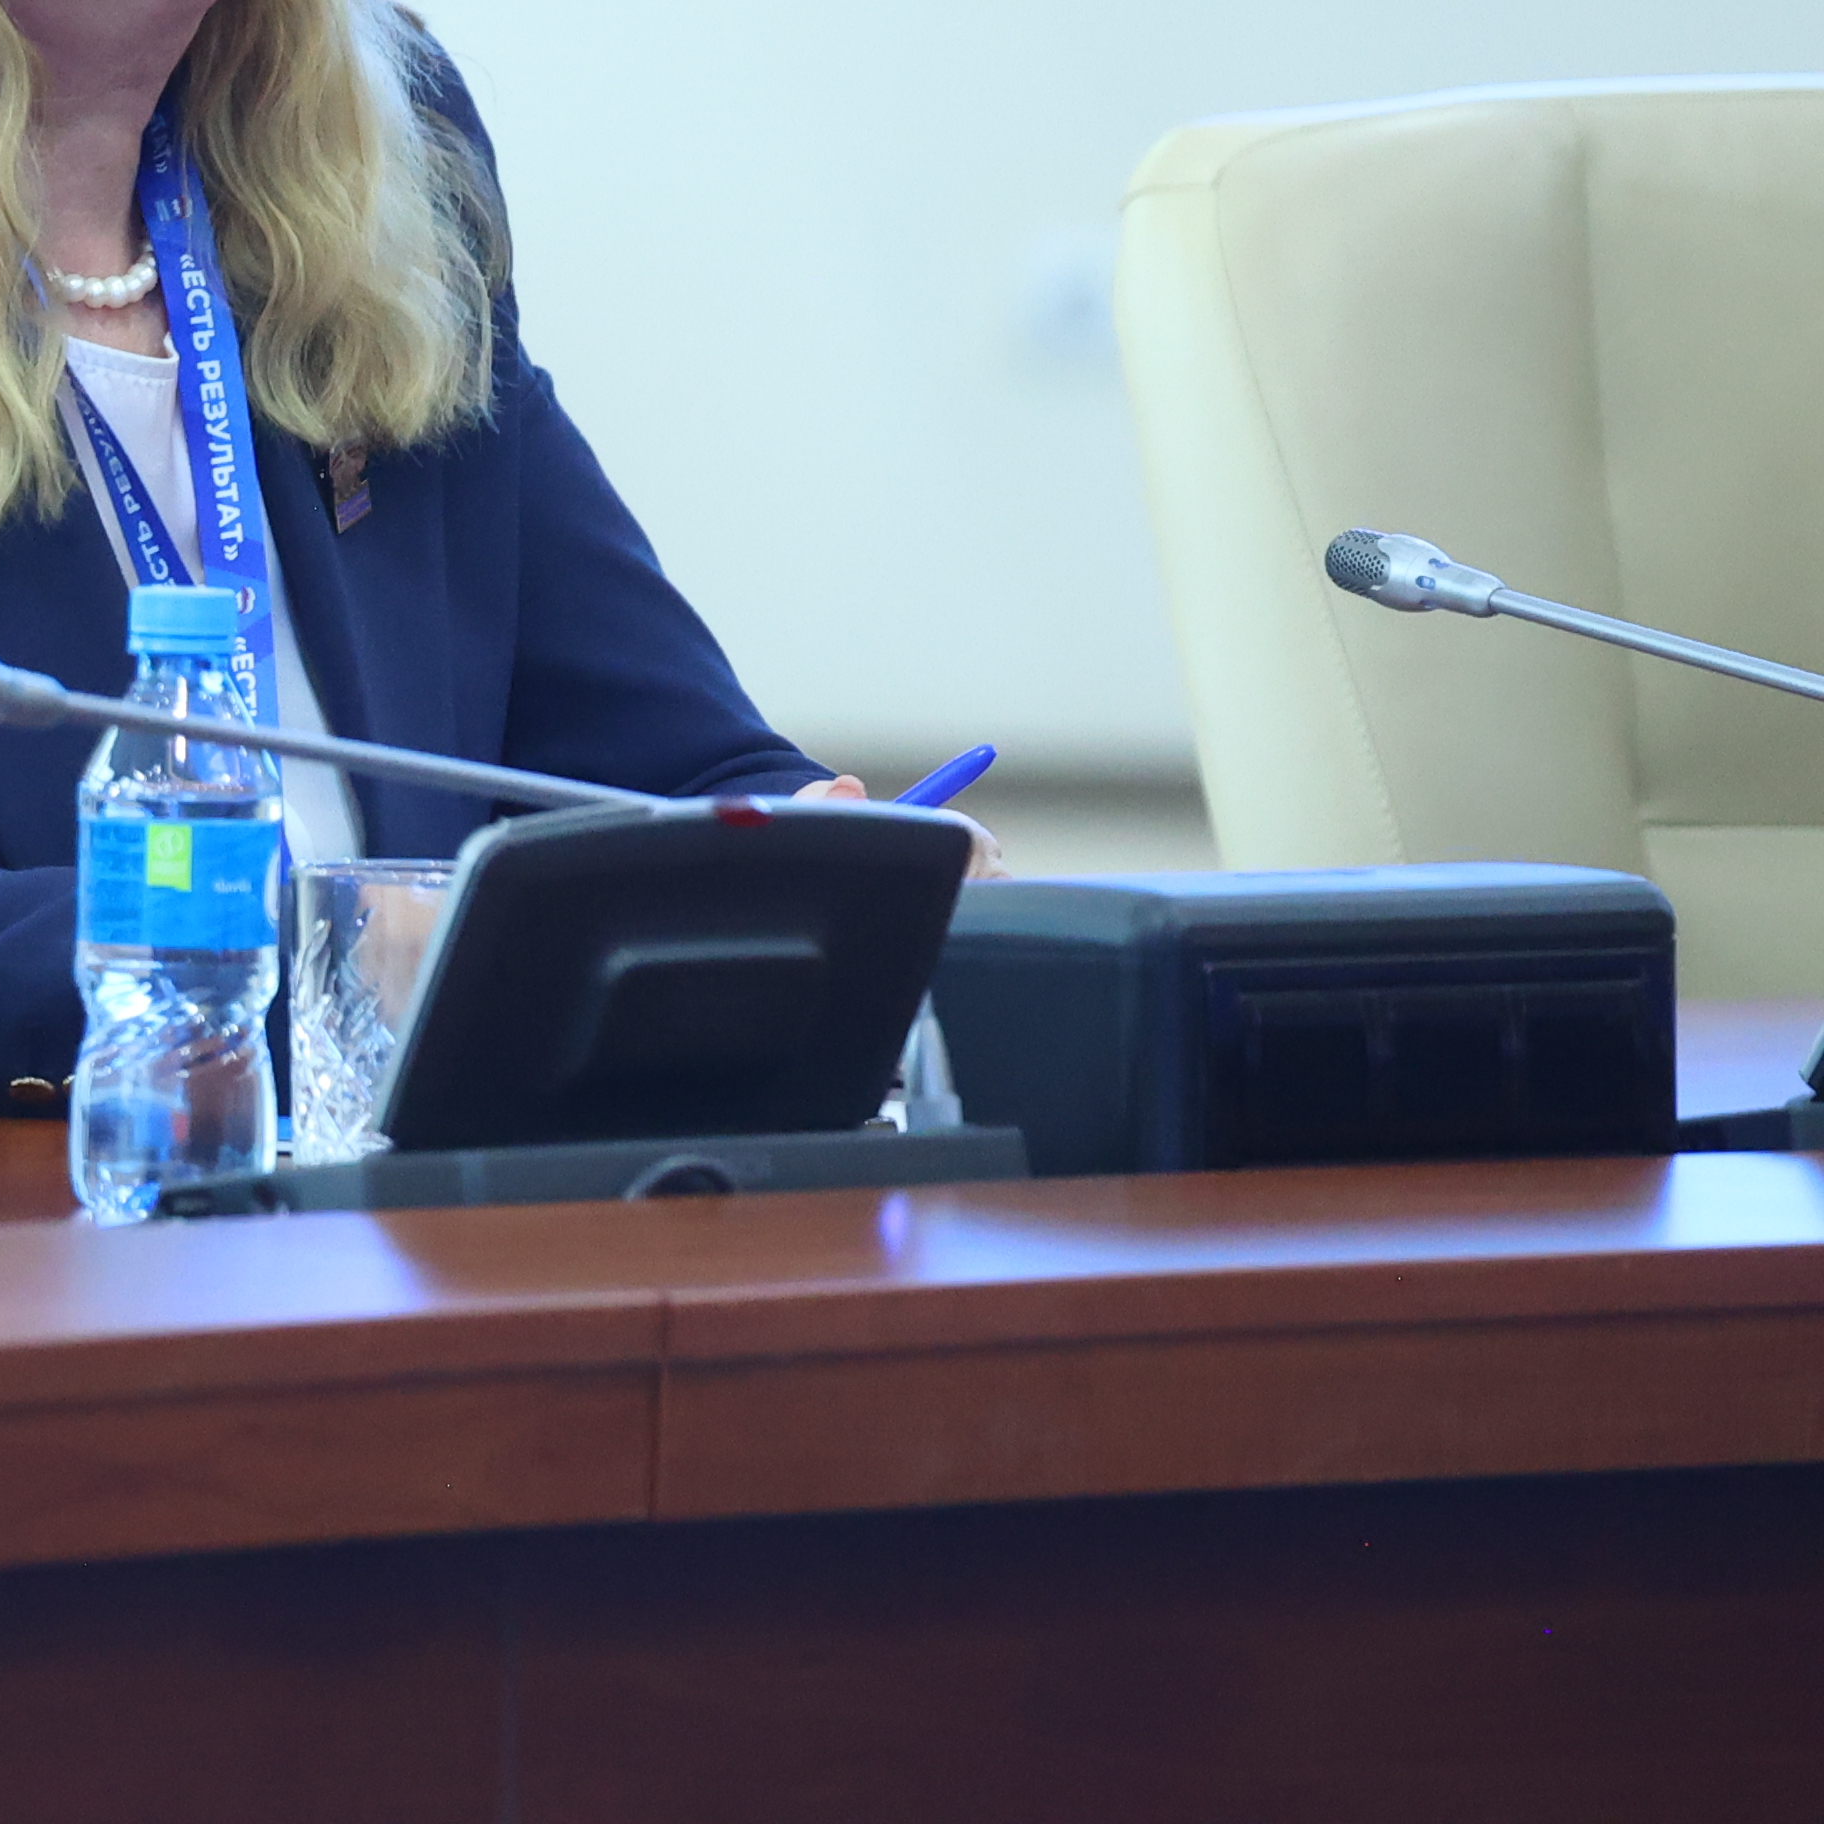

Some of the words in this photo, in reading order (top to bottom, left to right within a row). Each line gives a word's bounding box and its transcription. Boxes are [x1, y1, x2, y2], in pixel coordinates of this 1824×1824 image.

[180, 254, 215, 351] «ЕСТЬ
[197, 360, 243, 561] РЕЗУЛЬТАТ»
[138, 520, 176, 588] СТЬ
[231, 637, 258, 717] «ЕСТ
